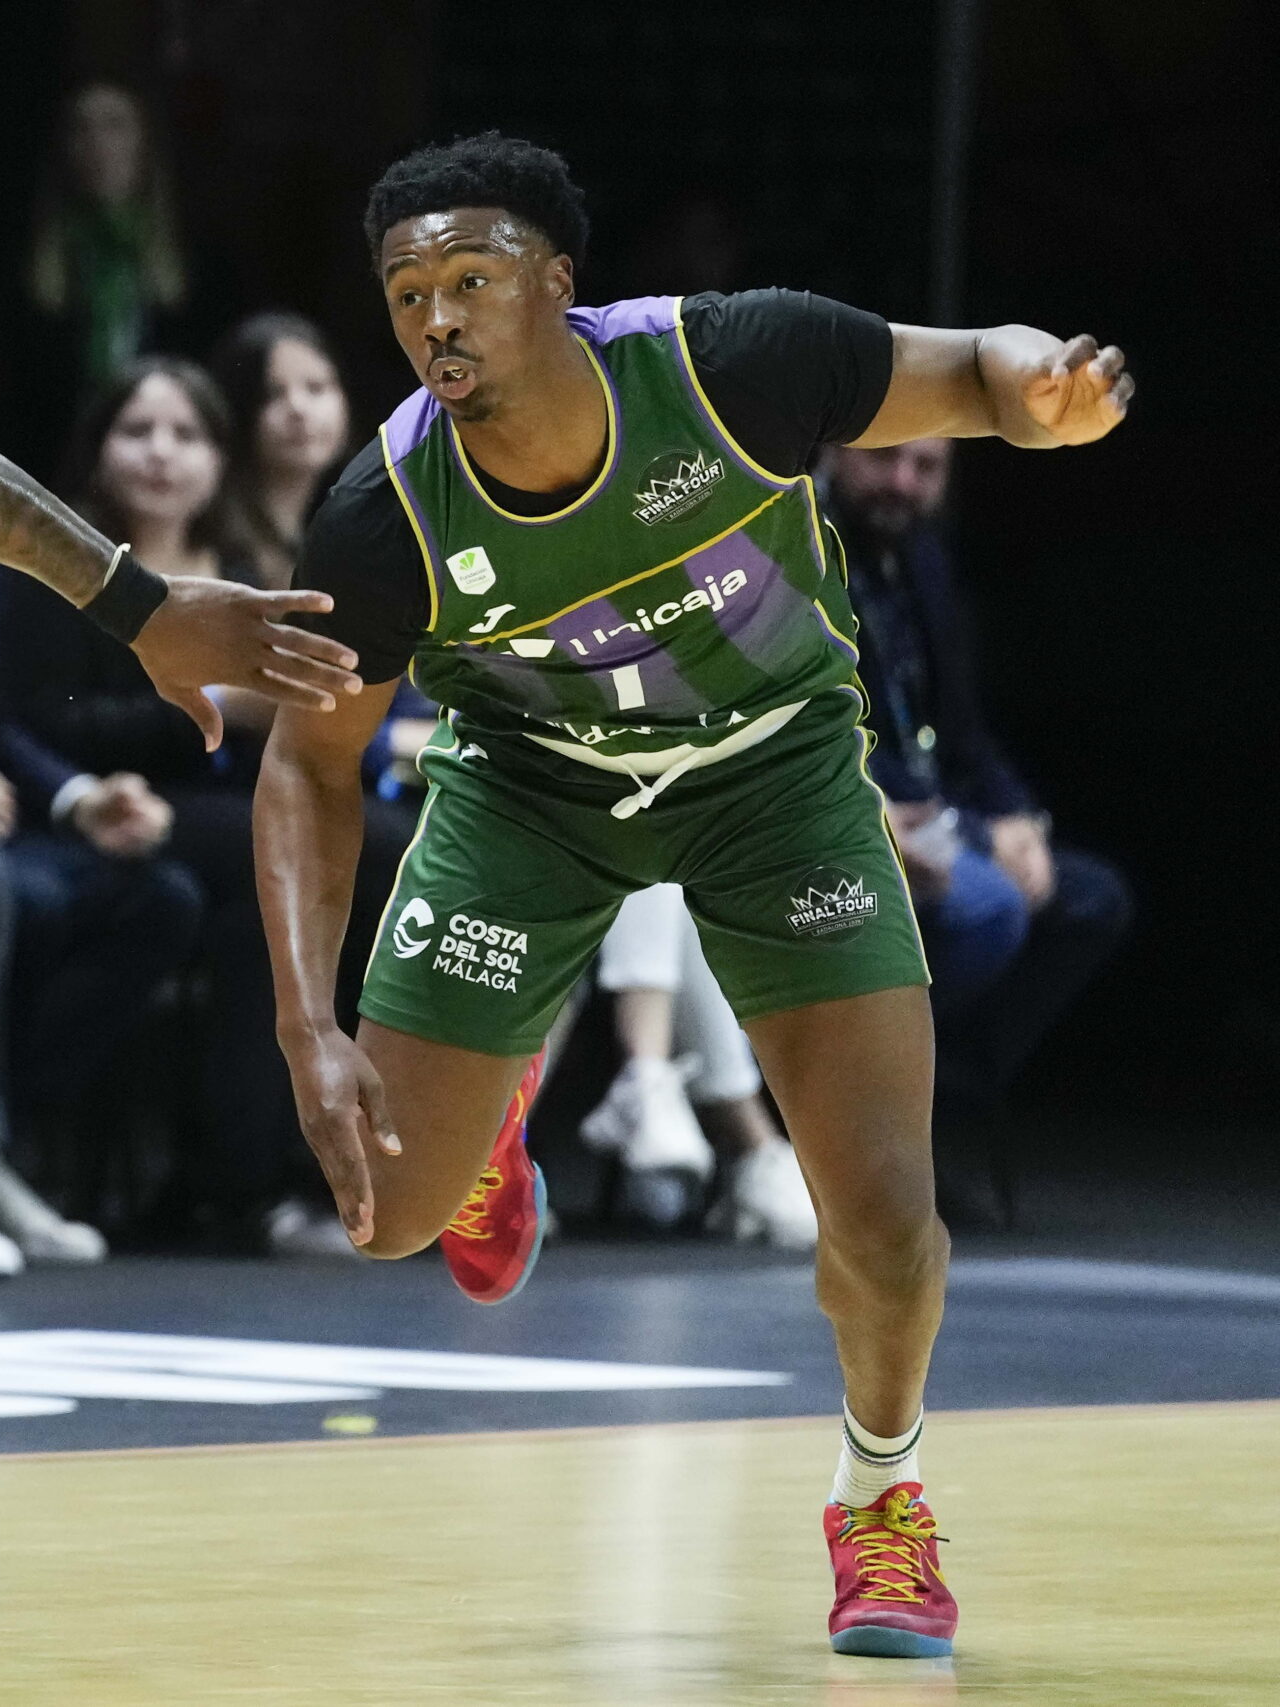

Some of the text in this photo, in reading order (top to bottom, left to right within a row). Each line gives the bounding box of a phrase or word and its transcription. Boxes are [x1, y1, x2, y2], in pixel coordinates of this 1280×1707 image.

[638, 465, 720, 520] FINAL FOUR
[609, 664, 646, 711] 1
[789, 896, 874, 927] FINAL FOUR
[449, 913, 528, 954] COSTA
[432, 955, 517, 993] MÁLAGA
[439, 934, 522, 974] DEL SOL
